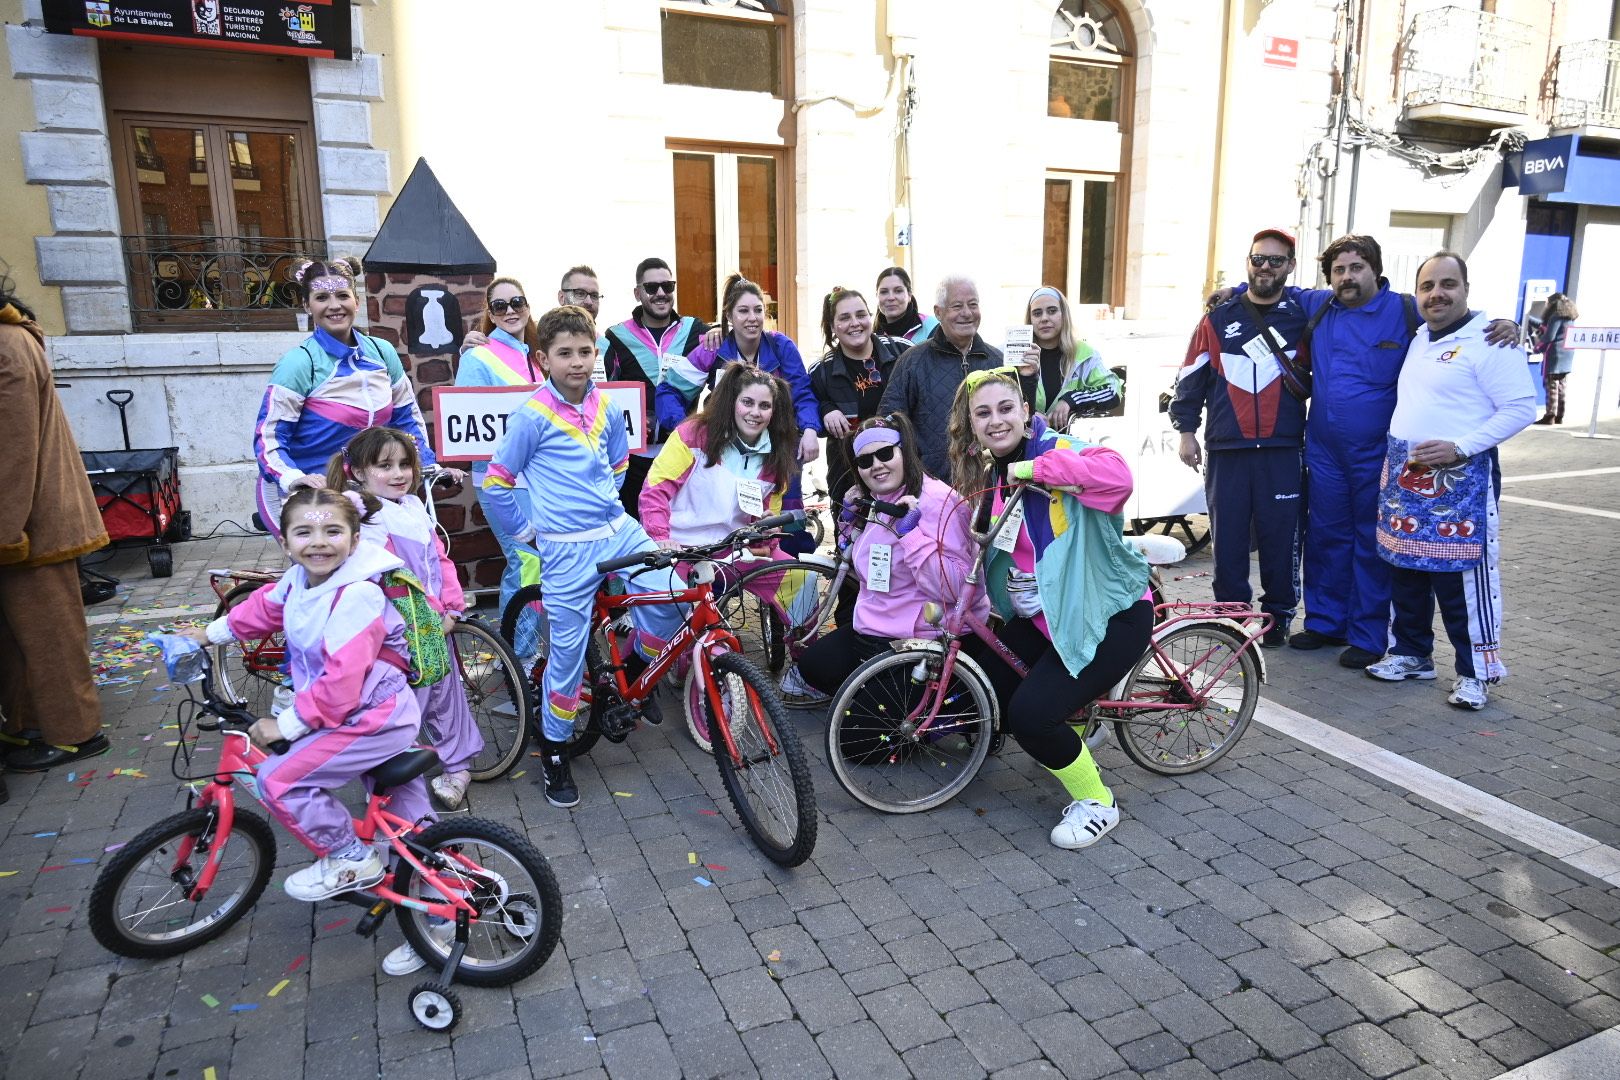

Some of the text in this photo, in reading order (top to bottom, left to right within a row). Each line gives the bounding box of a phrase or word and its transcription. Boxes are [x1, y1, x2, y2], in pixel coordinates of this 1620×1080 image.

[114, 7, 172, 19] Ayuntamiento
[223, 6, 265, 17] DECLARADO
[127, 16, 139, 24] La
[140, 17, 174, 27] Bañeza
[225, 31, 260, 40] NACIONAL
[1524, 155, 1565, 175] BBVA
[1573, 333, 1587, 343] LA
